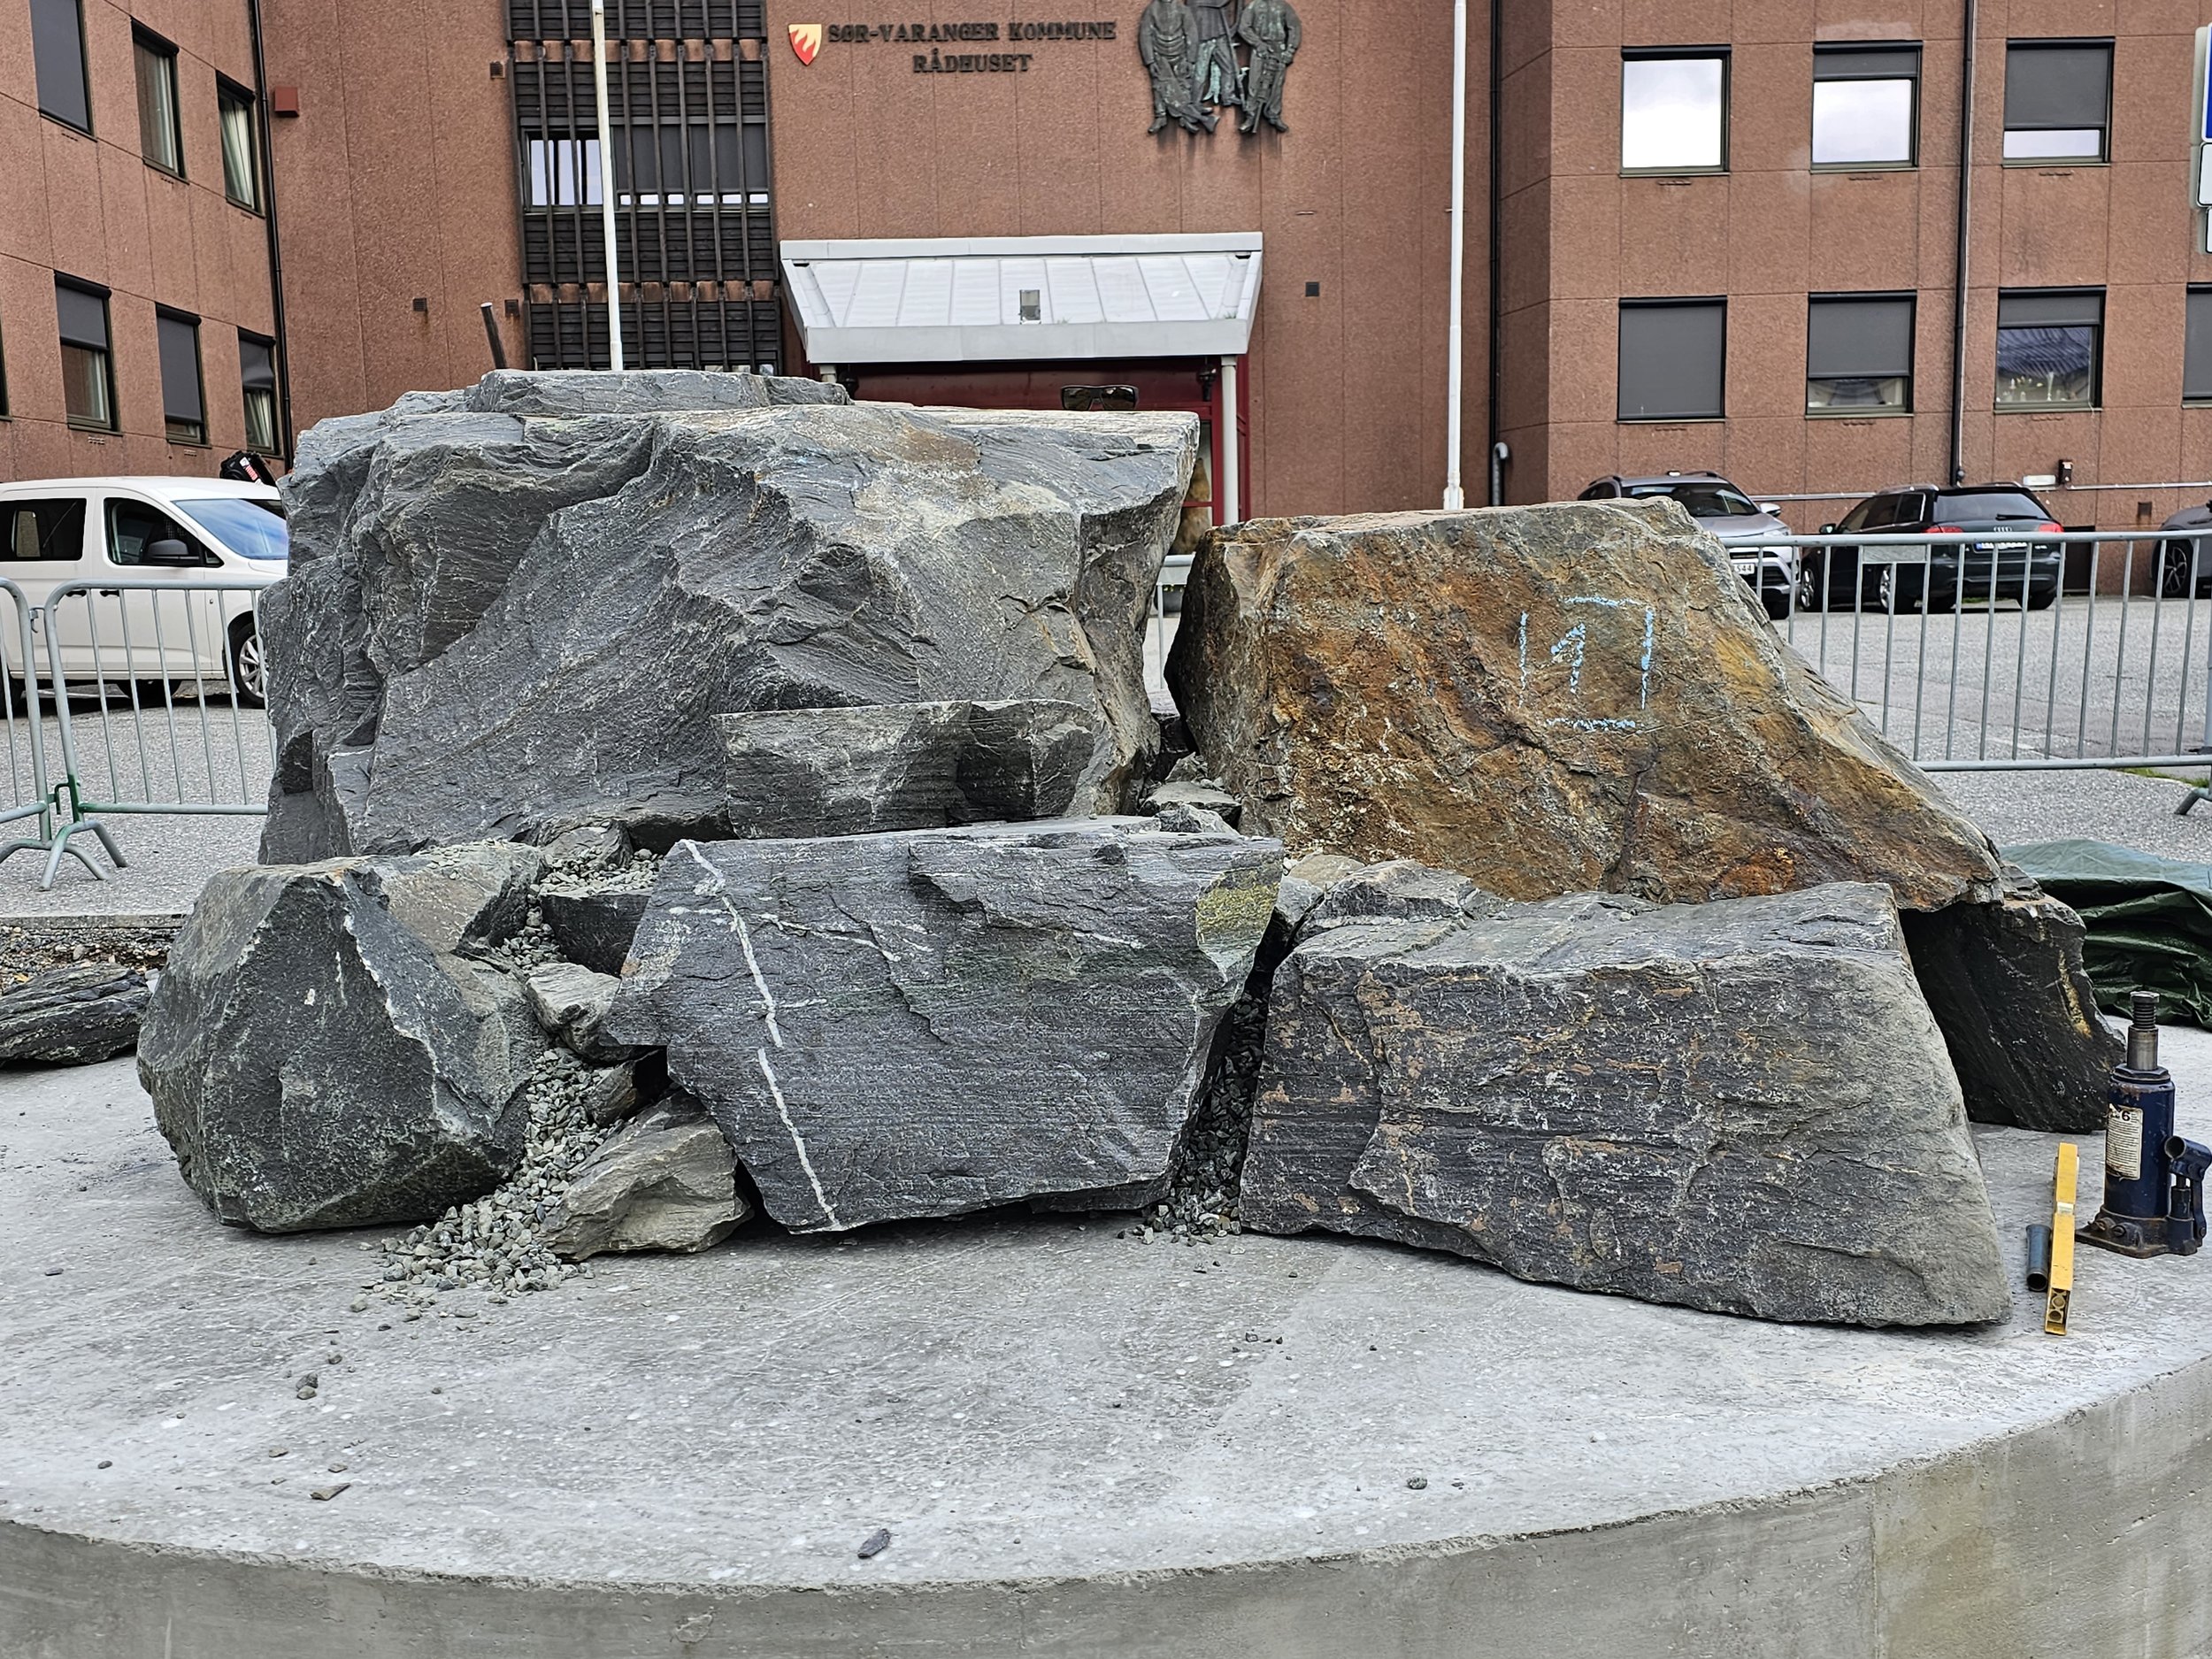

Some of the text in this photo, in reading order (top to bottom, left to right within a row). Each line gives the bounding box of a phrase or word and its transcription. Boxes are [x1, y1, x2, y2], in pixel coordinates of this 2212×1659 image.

[828, 21, 1117, 42] SØR-VARANGER KOMMUNE
[913, 48, 1033, 73] RÅDHUSET
